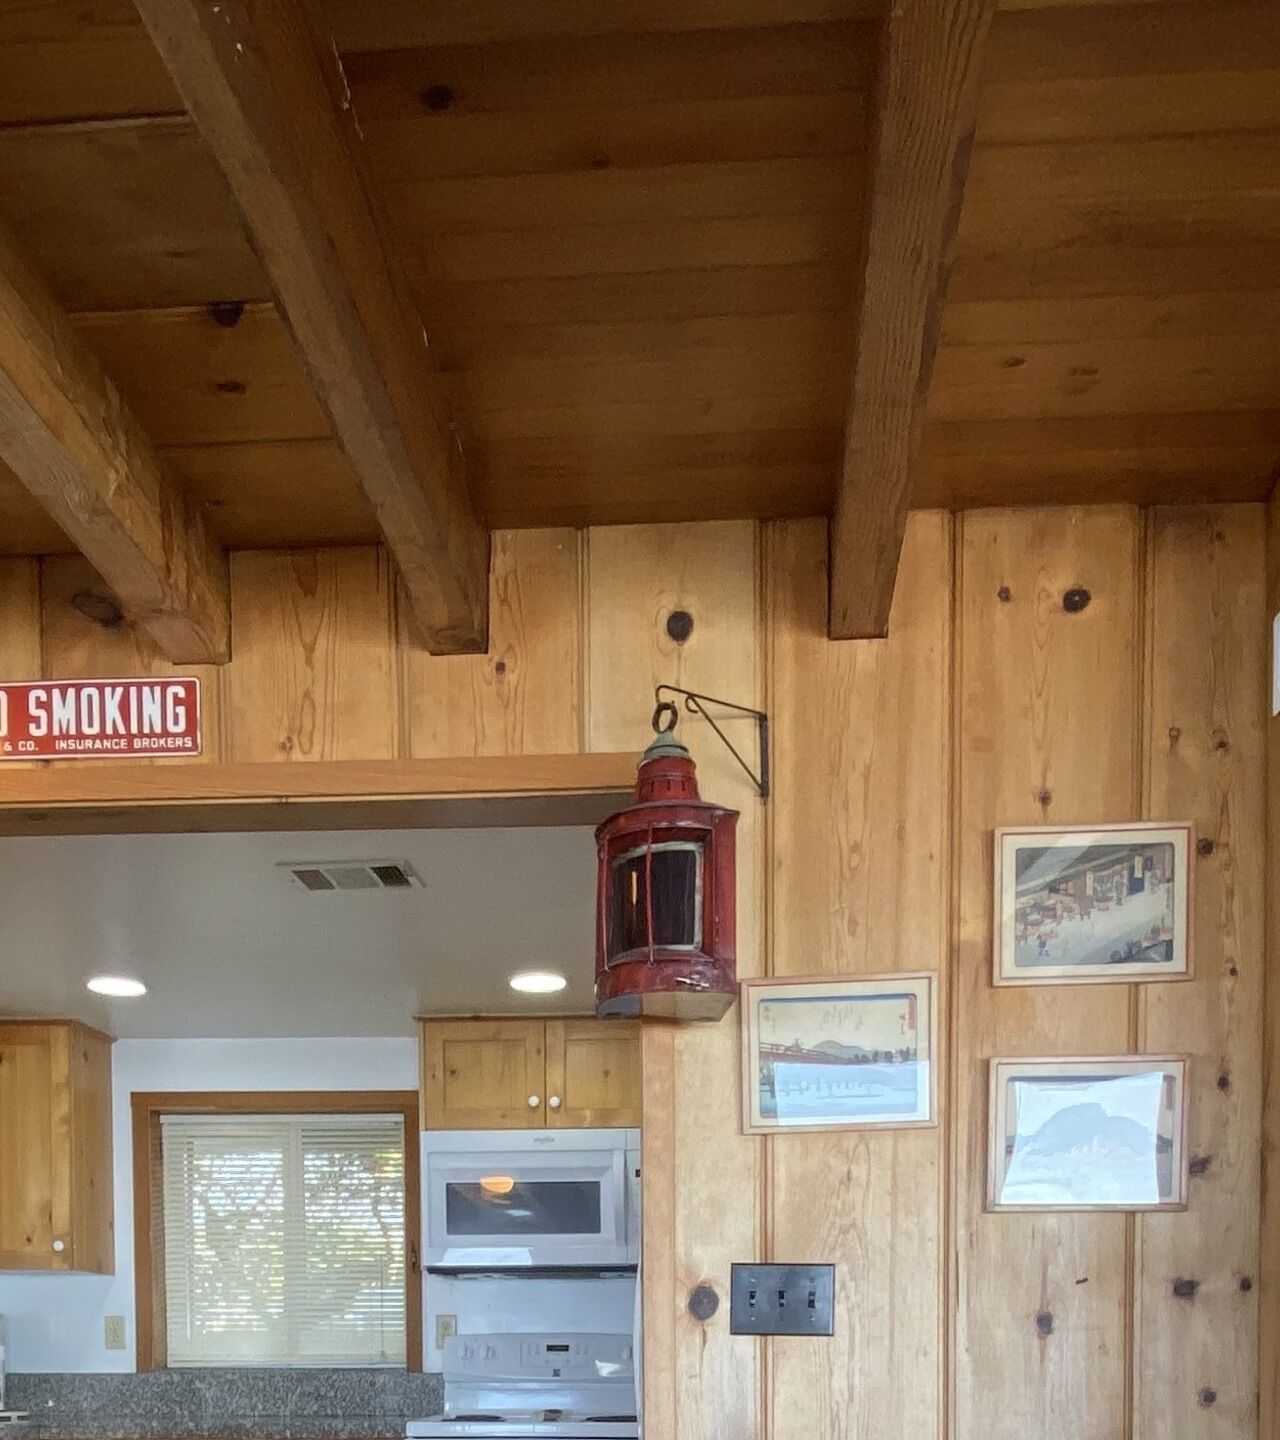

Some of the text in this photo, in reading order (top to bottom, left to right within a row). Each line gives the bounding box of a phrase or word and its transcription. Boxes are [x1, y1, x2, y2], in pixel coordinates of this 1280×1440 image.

[28, 685, 187, 737] SMOKING
[4, 741, 13, 752] &
[18, 740, 39, 751] CO.
[55, 738, 128, 750] INSURANCE
[133, 736, 193, 749] BROKERS
